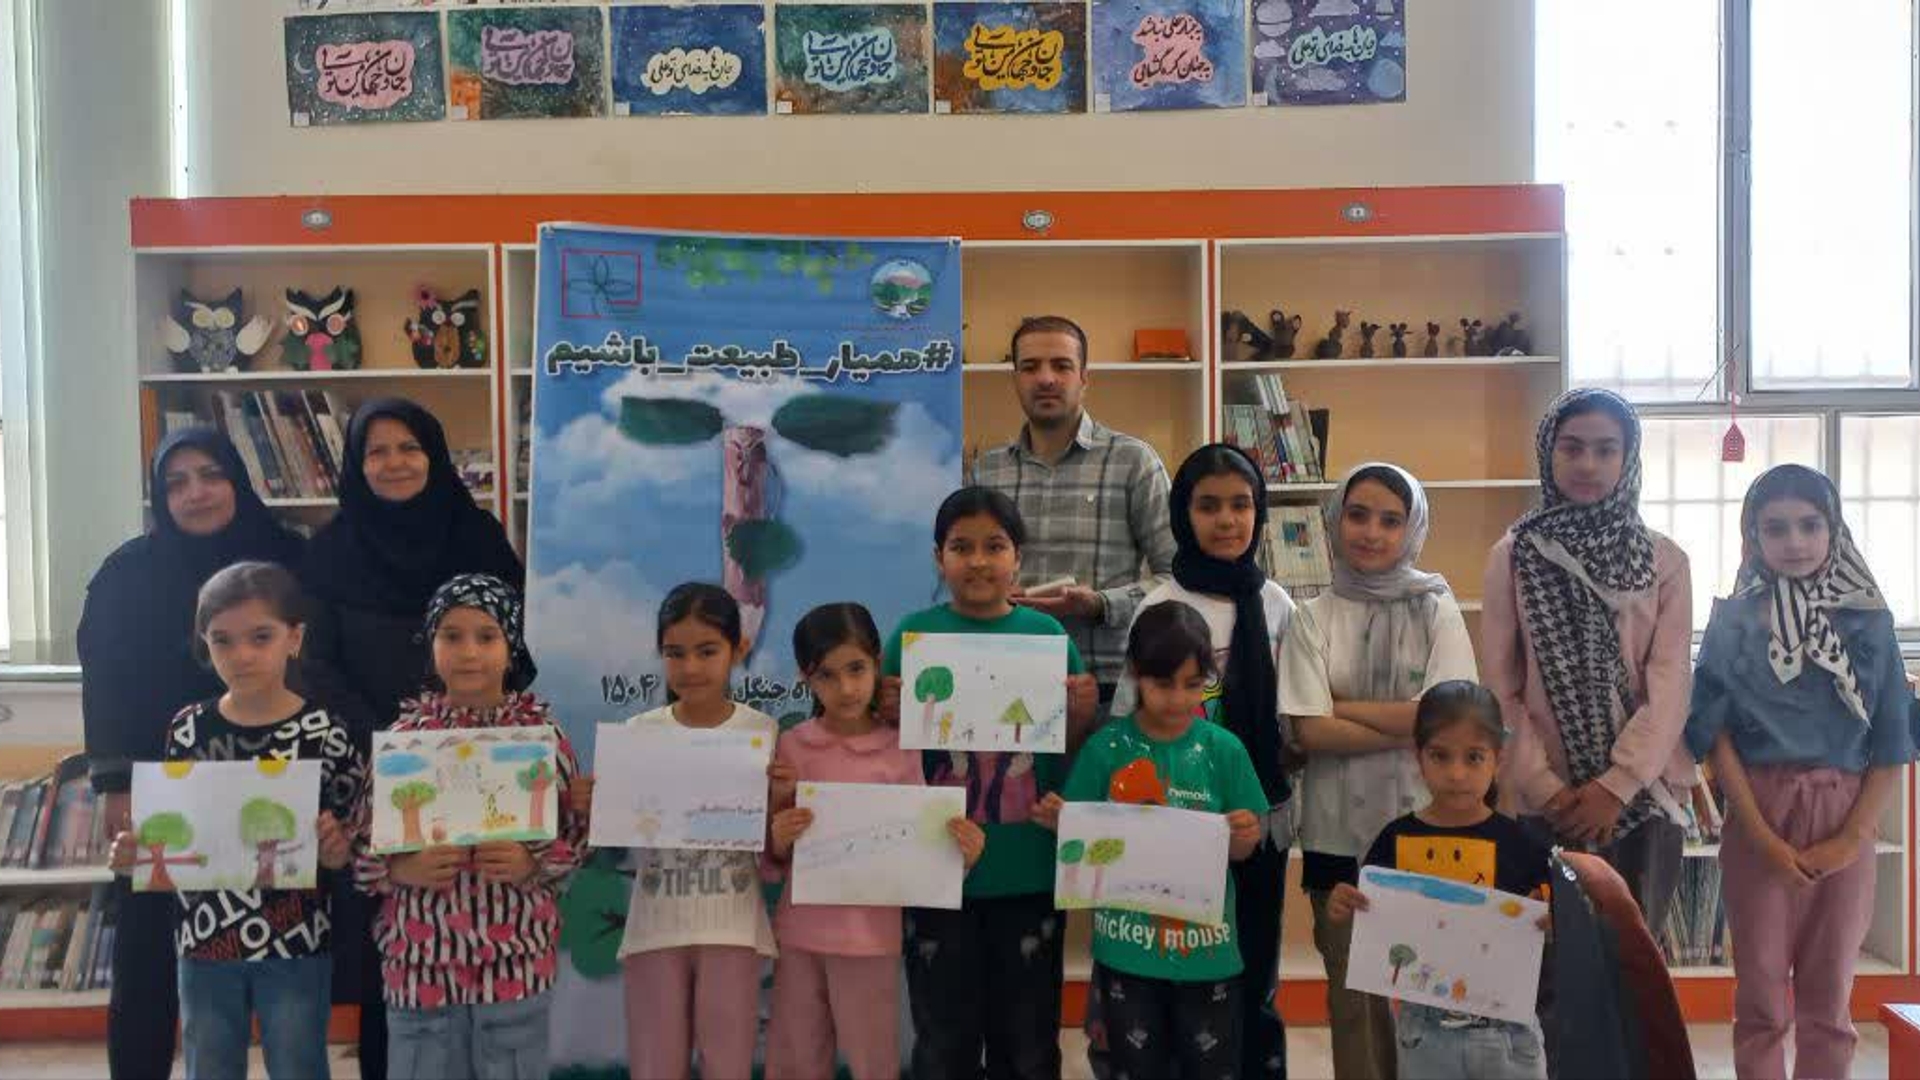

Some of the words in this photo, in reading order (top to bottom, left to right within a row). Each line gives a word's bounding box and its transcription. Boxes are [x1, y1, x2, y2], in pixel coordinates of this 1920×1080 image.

[1291, 38, 1308, 65] علی
[650, 60, 669, 83] علی
[602, 674, 658, 704] ۱۵۰۴
[731, 675, 788, 705] جنگل
[1094, 911, 1156, 951] mickey
[1164, 922, 1231, 951] mouse
